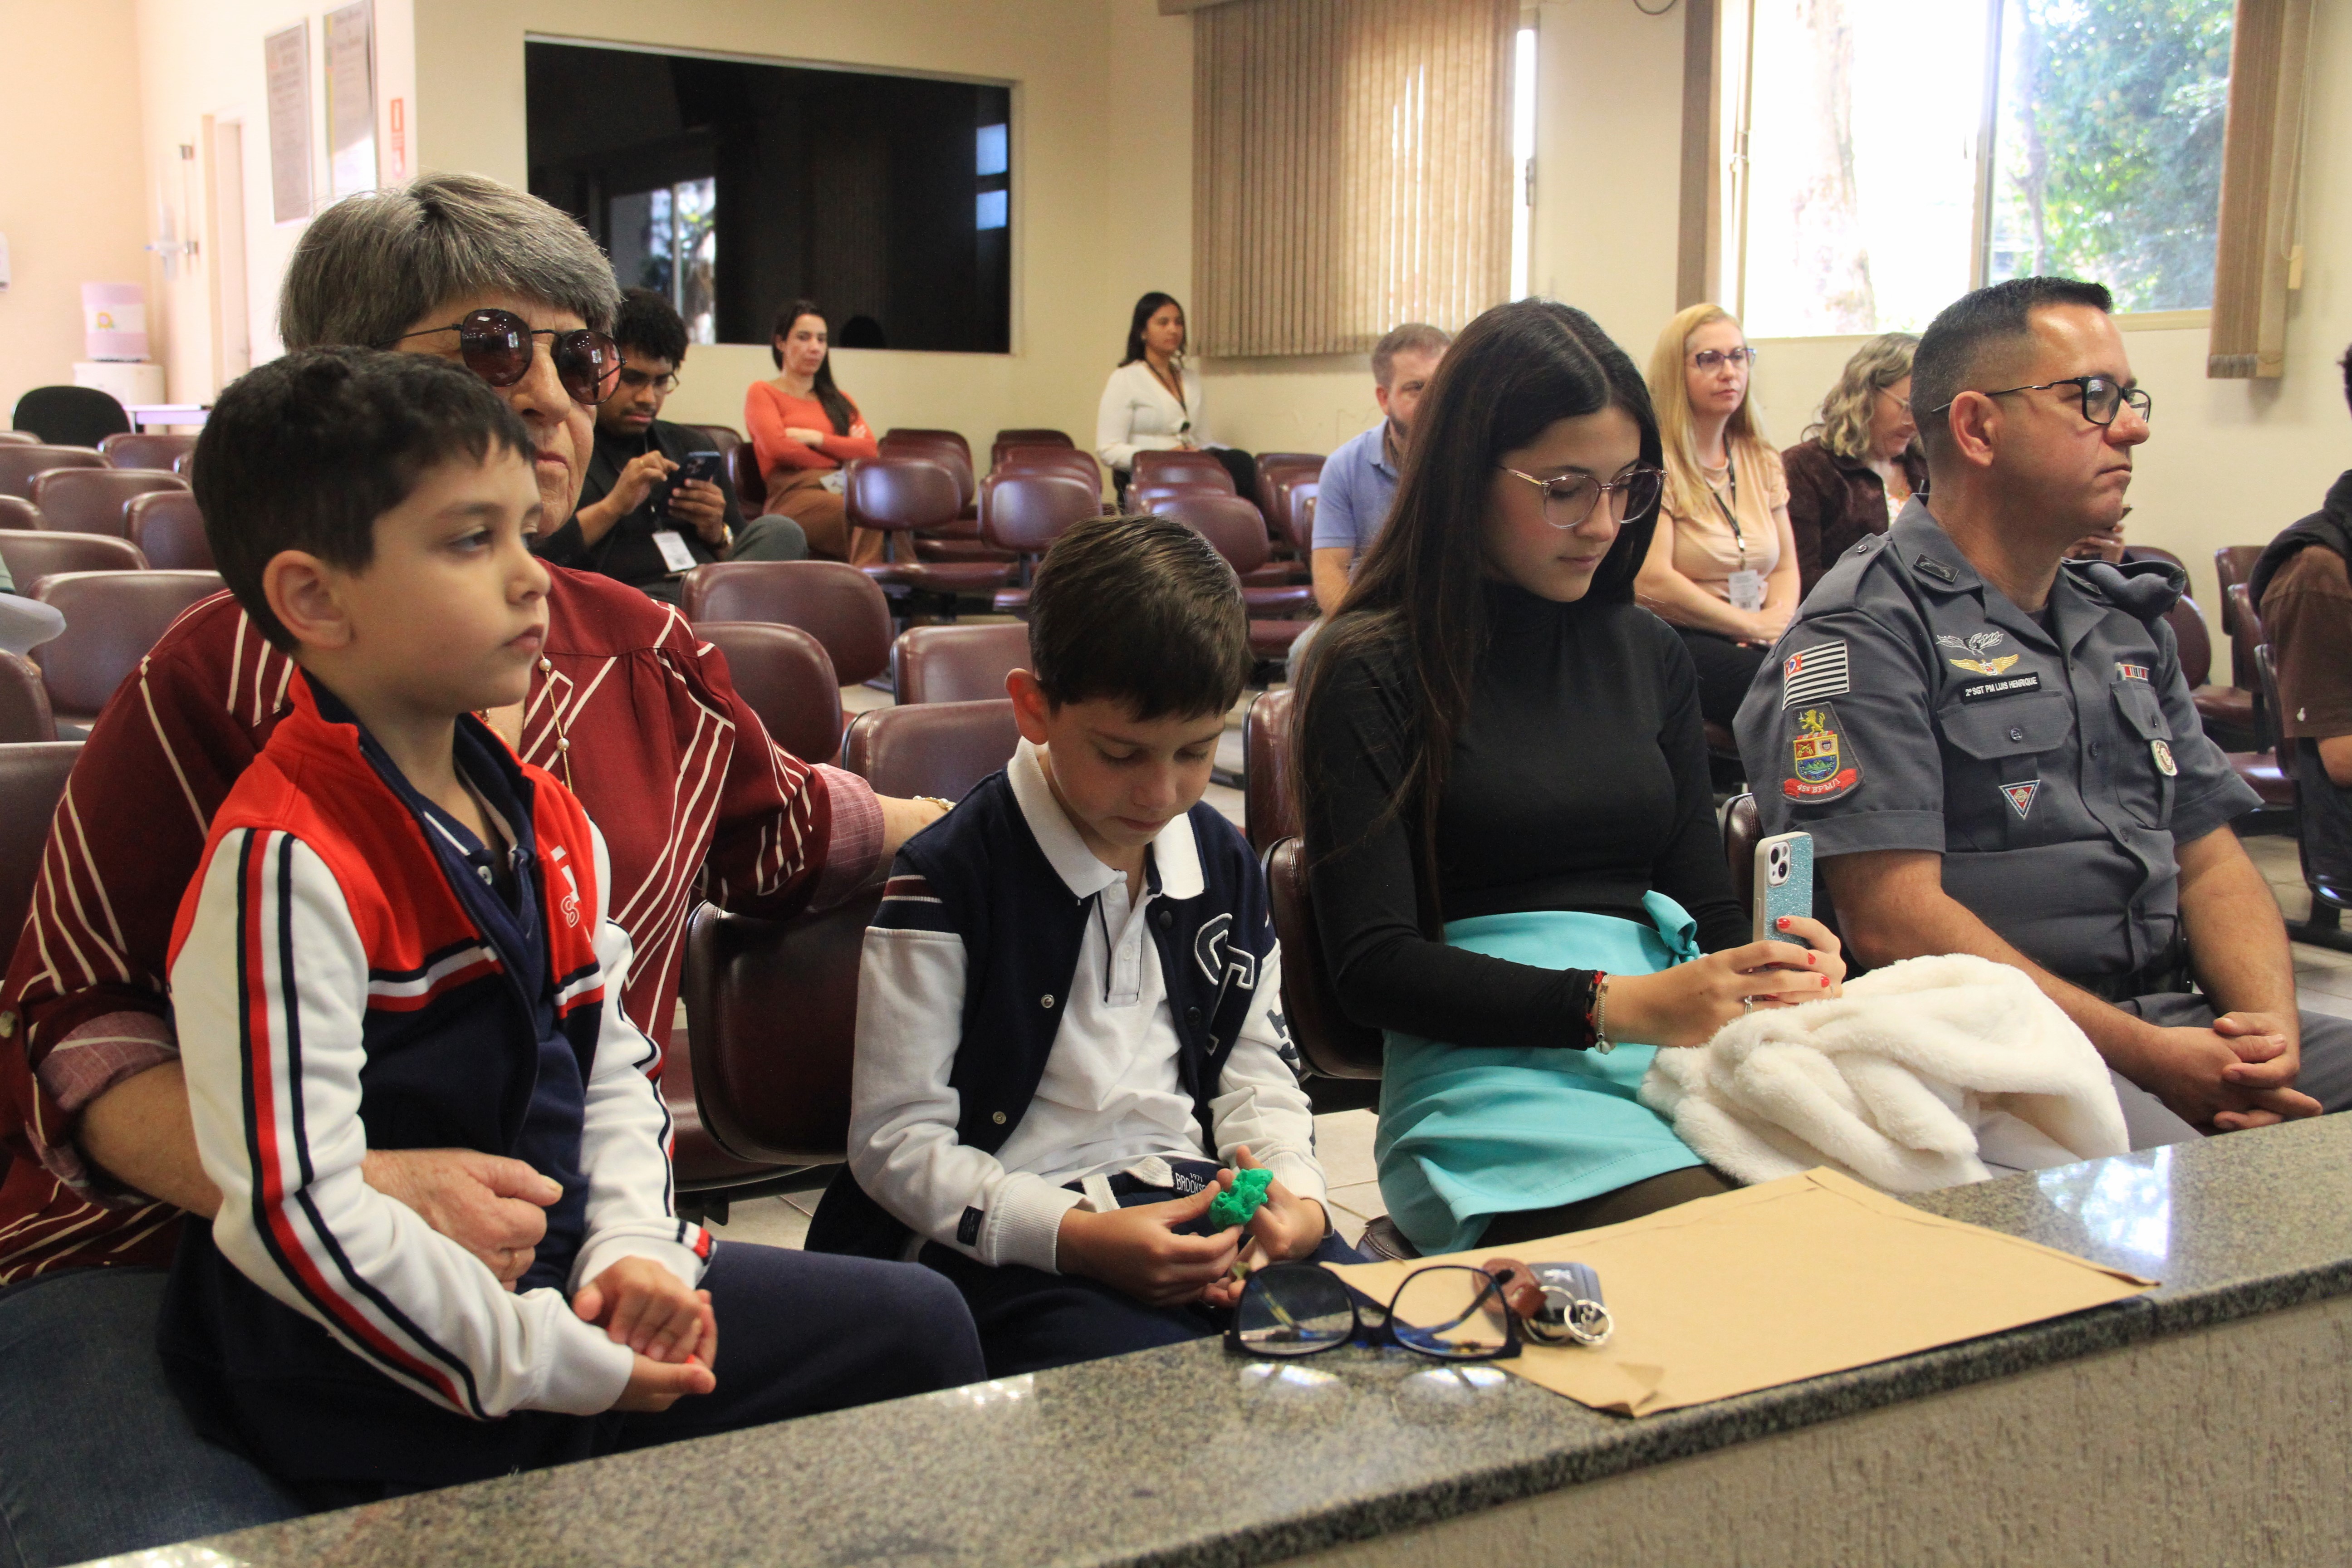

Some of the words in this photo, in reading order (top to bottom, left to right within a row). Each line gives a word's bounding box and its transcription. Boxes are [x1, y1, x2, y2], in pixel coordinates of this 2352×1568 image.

[1972, 686, 1984, 696] SGT
[1984, 684, 1995, 693] PM
[1994, 681, 2009, 691] LUIS
[2008, 676, 2038, 689] HENRIQUE
[1190, 1172, 1203, 1182] 1971
